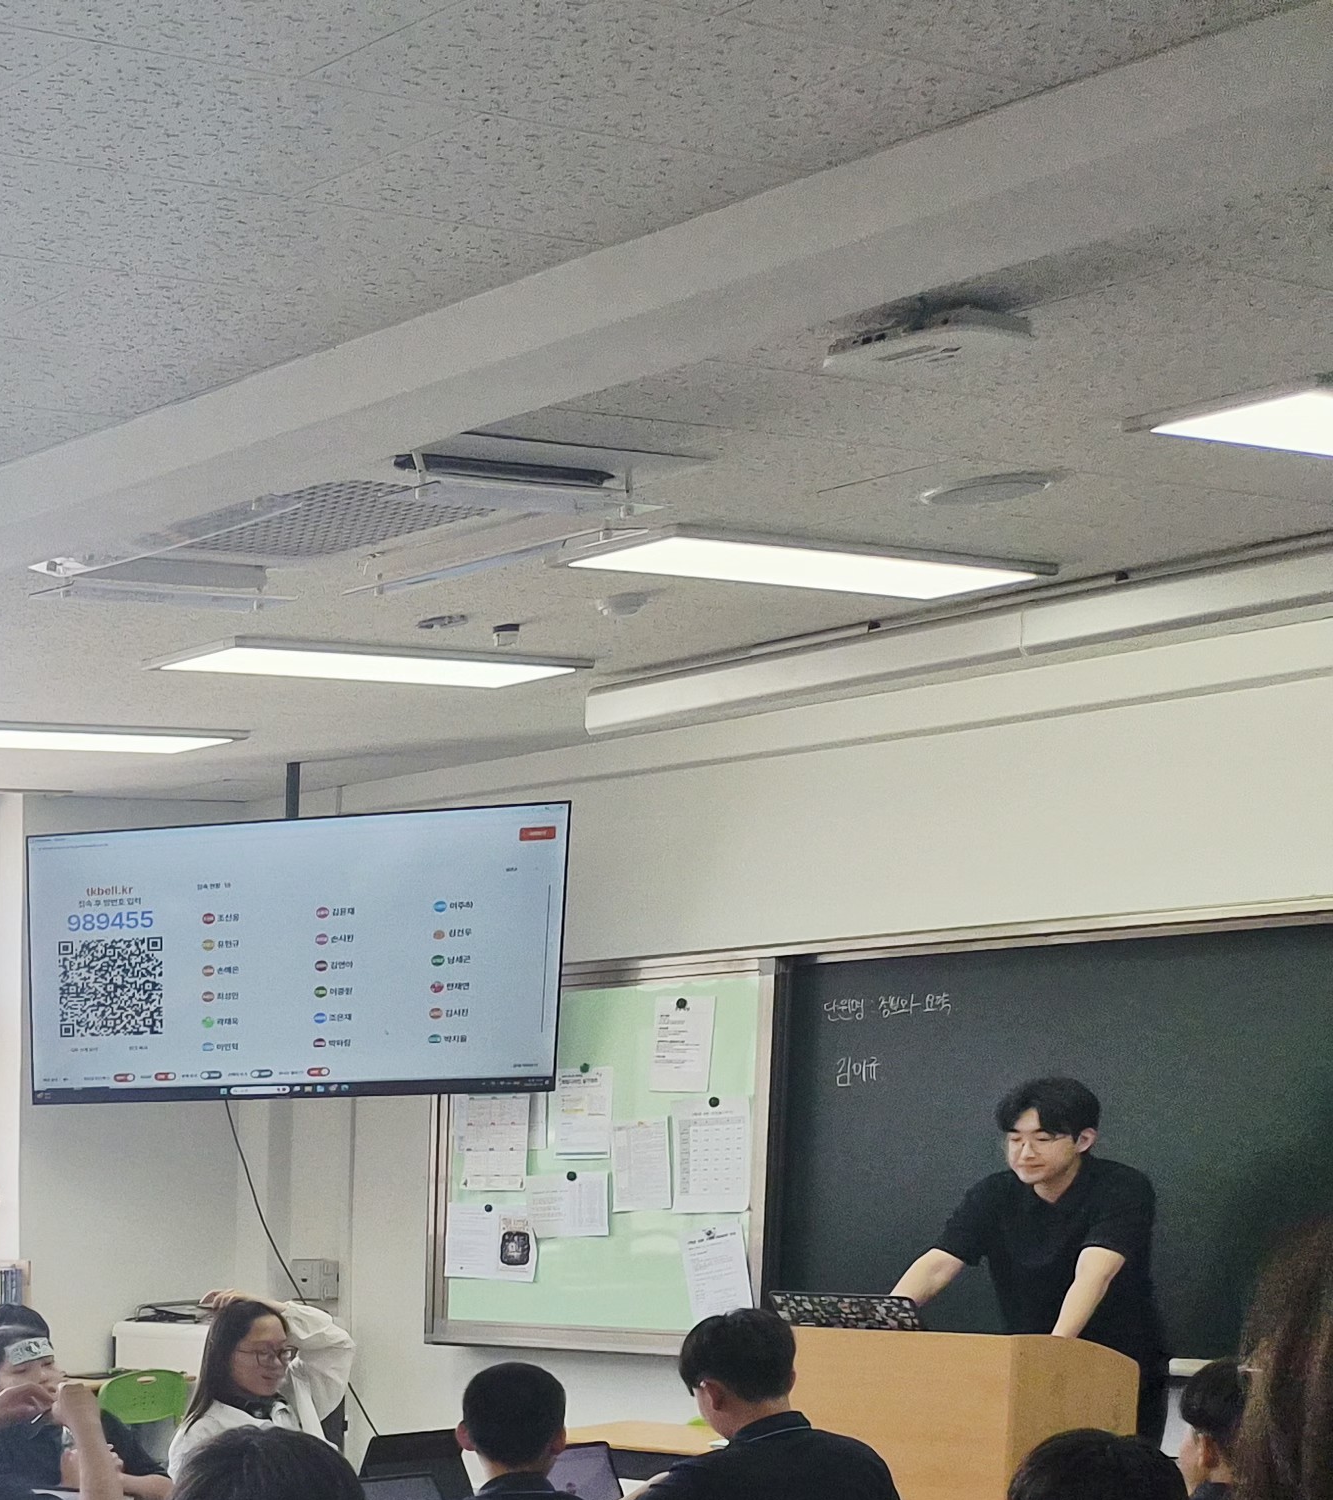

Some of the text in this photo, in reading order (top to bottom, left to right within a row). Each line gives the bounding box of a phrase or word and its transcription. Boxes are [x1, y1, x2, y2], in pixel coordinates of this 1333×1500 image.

[86, 885, 134, 897] tkbell.kr
[67, 910, 154, 932] 989455
[823, 998, 865, 1022] 단원명
[878, 993, 922, 1019] 정보와
